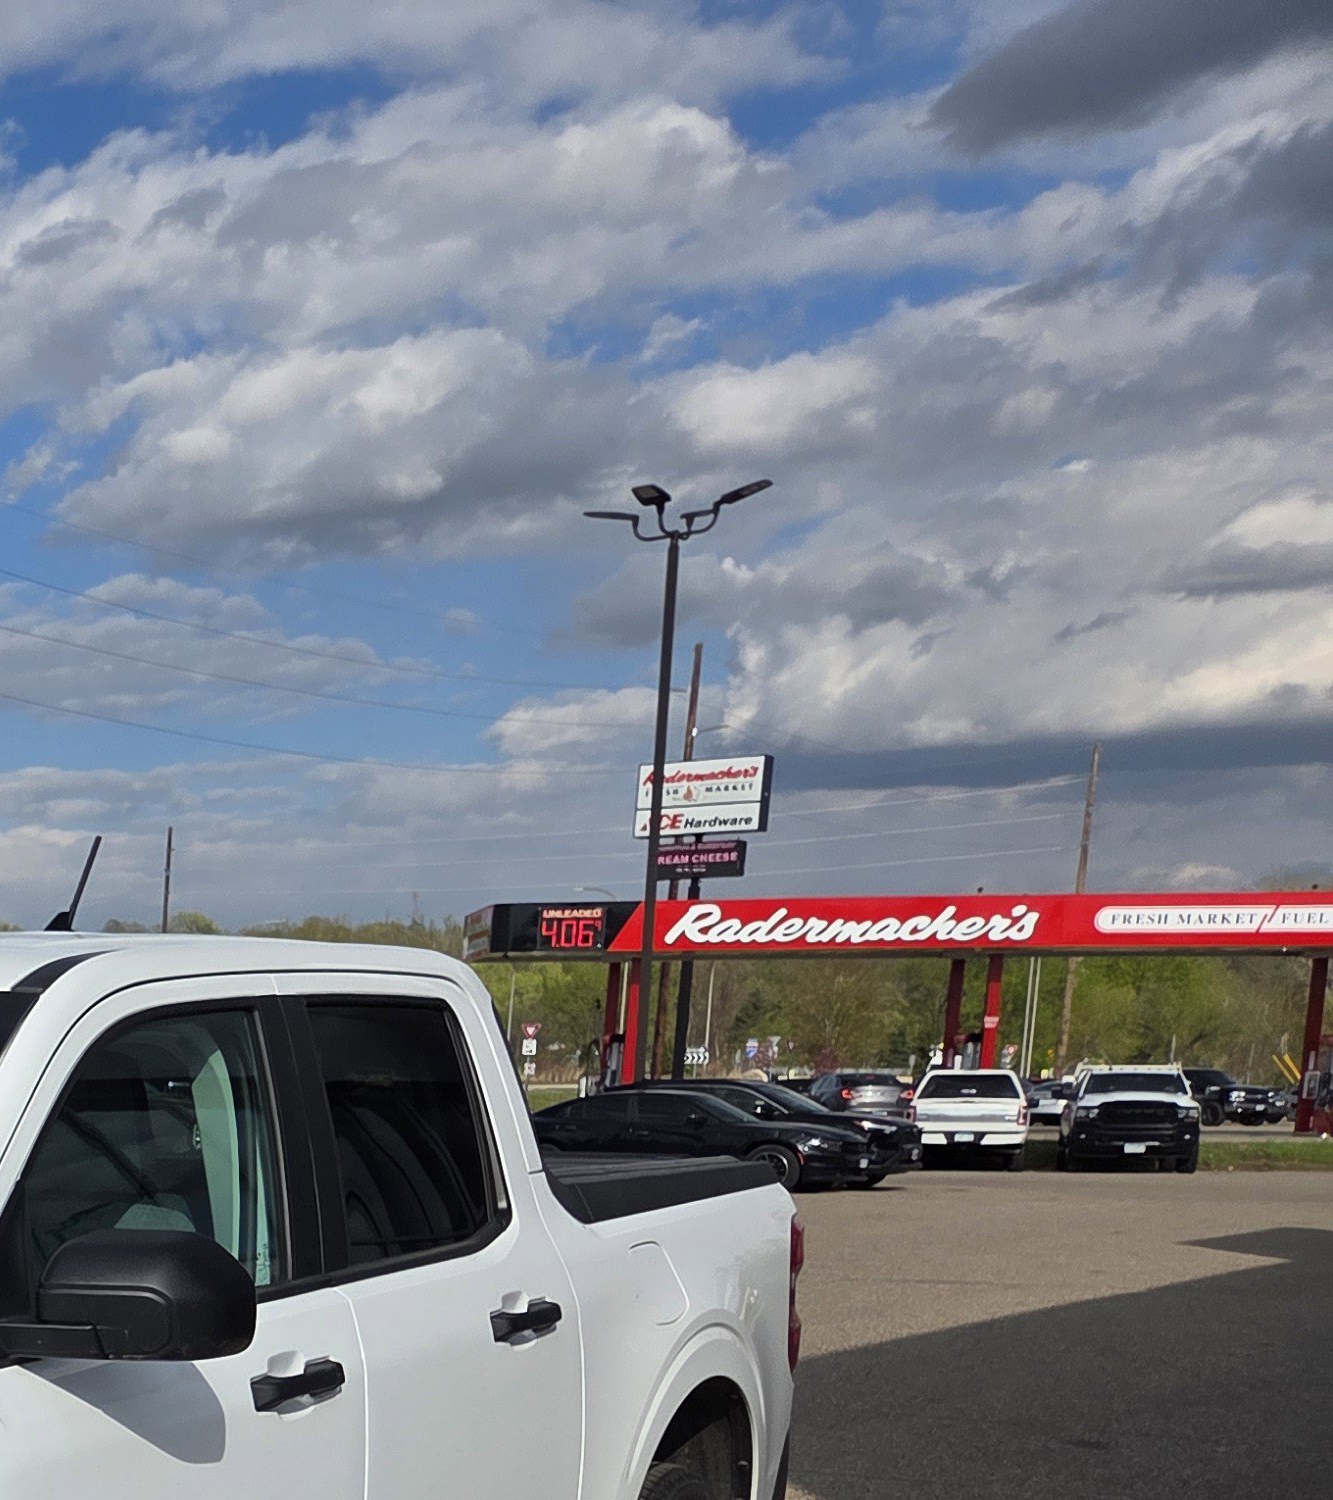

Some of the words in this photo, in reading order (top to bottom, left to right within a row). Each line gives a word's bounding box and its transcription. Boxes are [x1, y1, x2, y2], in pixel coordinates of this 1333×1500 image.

[684, 816, 753, 829] Hardware
[657, 854, 690, 866] REAM
[692, 851, 738, 863] CHEESE
[542, 908, 603, 919] UNLEADED
[1111, 912, 1169, 925] FRESH
[1177, 912, 1258, 925] MARKET
[1282, 911, 1331, 924] FUEL
[664, 903, 1041, 945] Radermacher's
